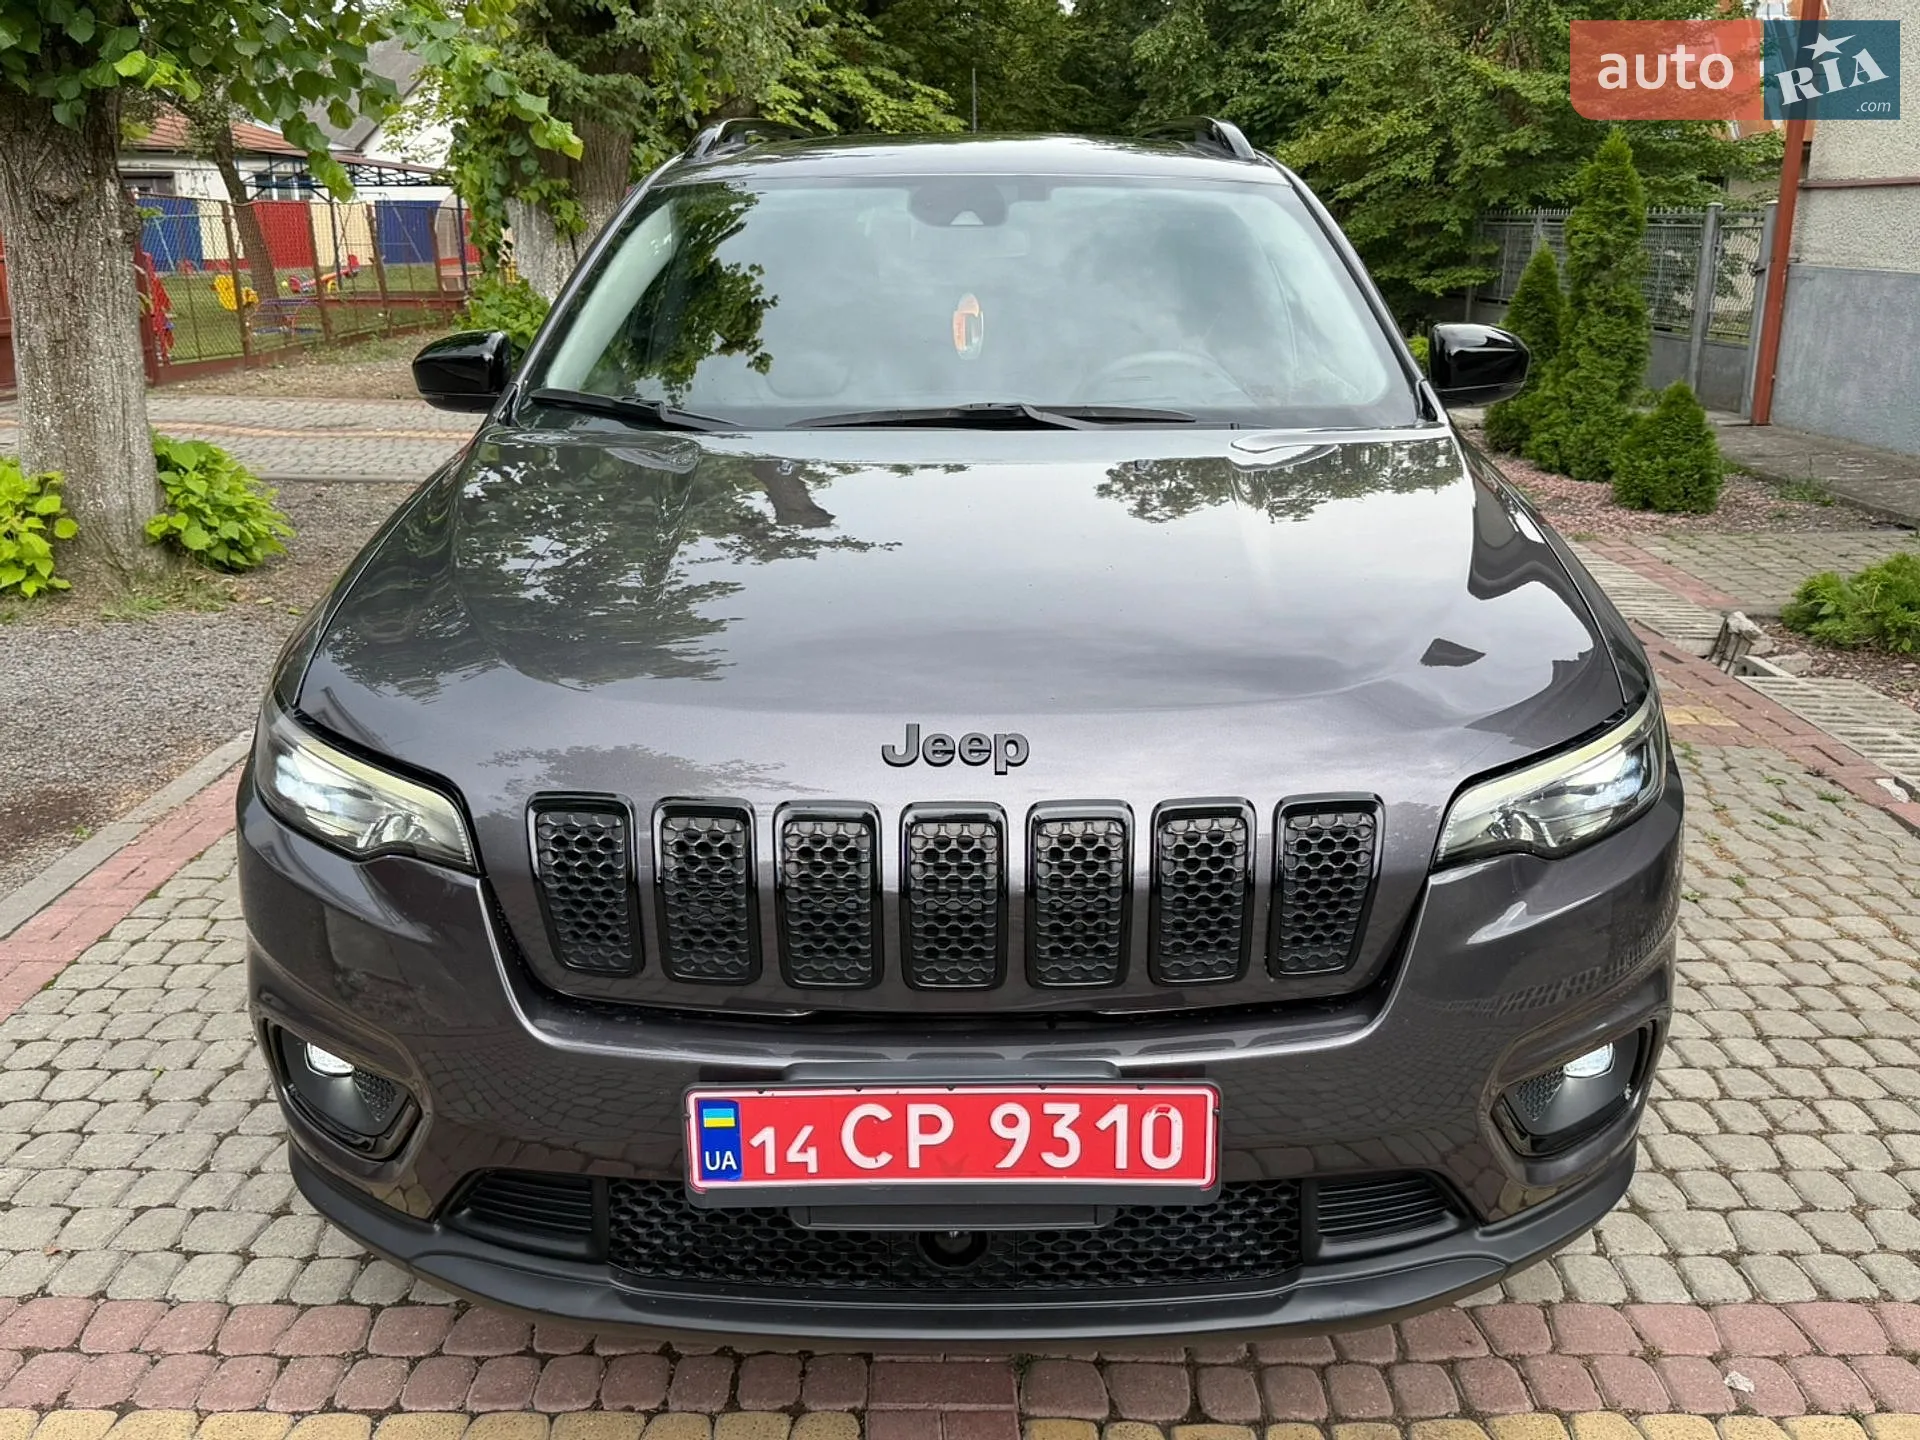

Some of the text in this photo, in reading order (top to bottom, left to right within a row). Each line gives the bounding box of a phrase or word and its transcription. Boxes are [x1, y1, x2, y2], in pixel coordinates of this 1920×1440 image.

[881, 723, 1030, 776] Jeep
[704, 1151, 738, 1172] UA
[748, 1101, 1184, 1174] 14 CP 9310
